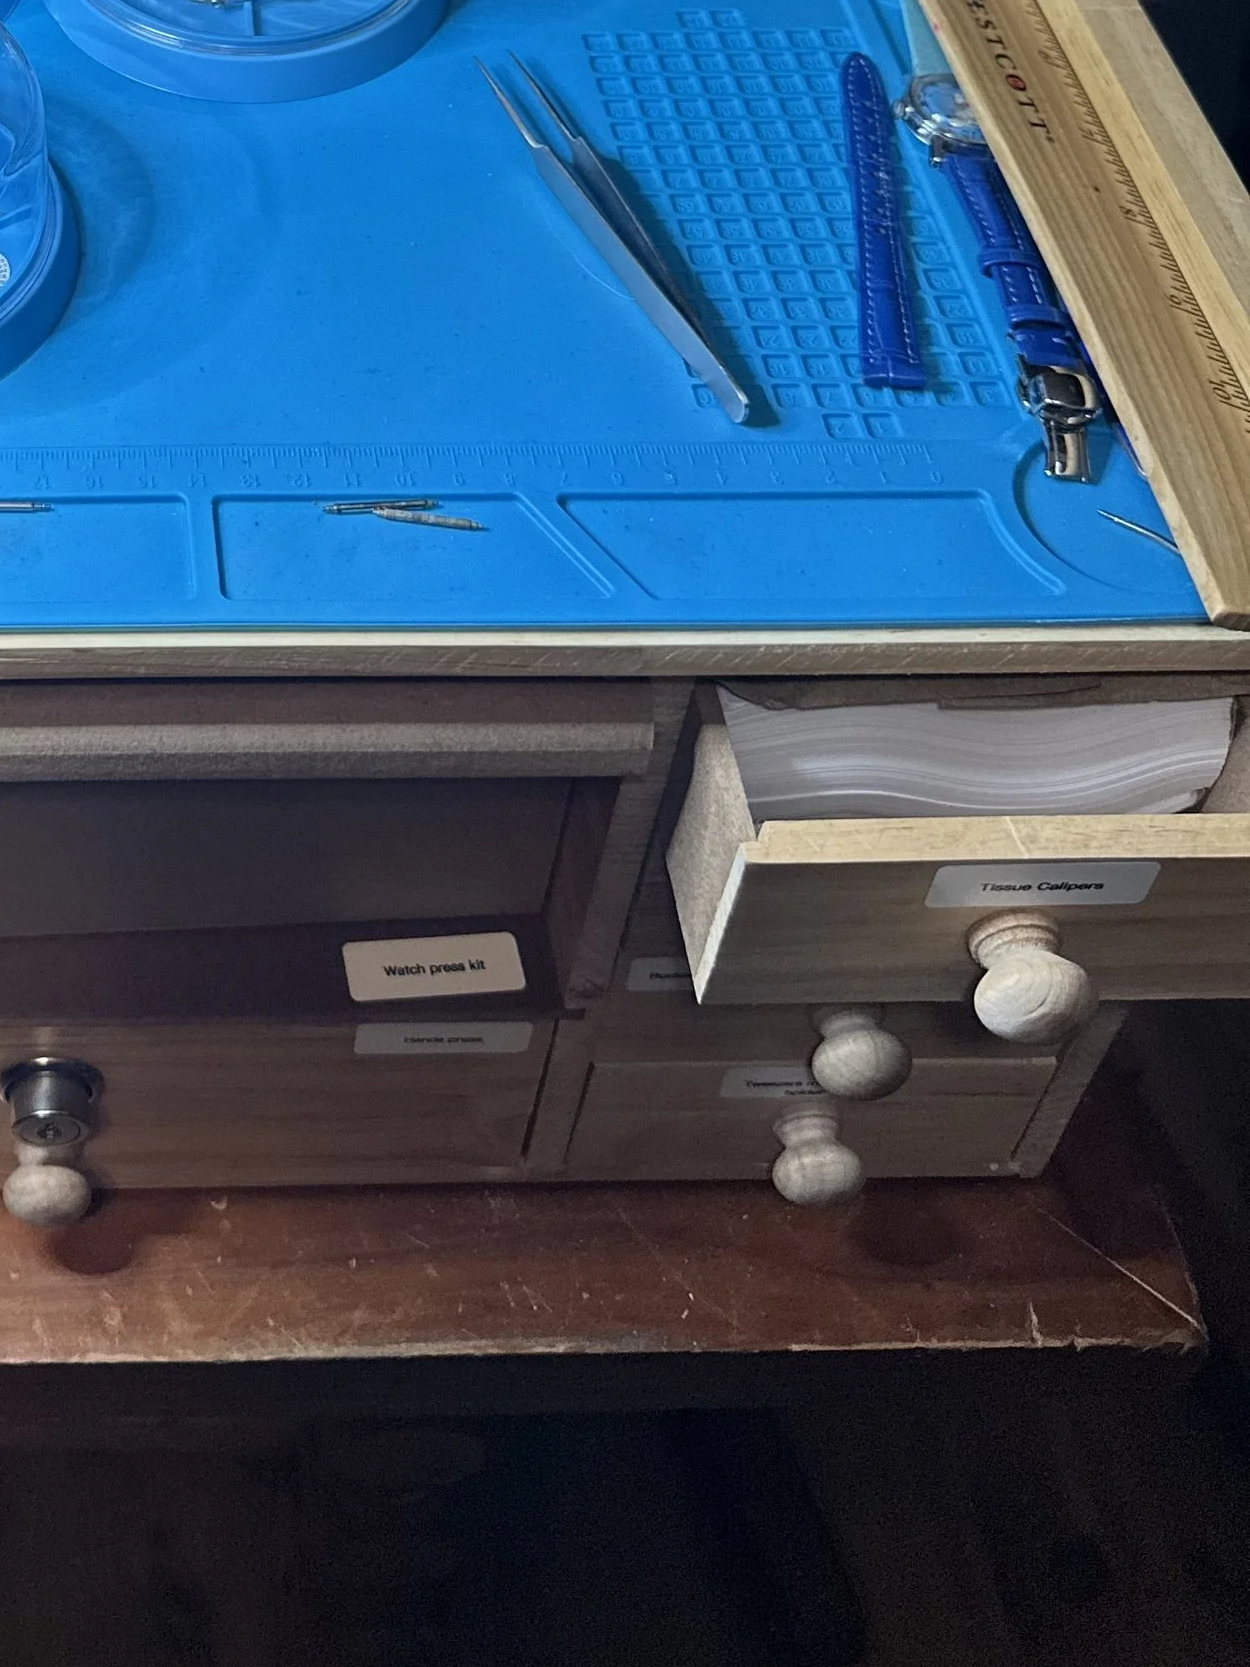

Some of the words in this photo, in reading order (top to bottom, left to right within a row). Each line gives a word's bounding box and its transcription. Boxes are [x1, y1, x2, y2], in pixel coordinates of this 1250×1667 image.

[980, 881, 1032, 892] Tissue
[1036, 880, 1105, 893] Calipers
[383, 961, 426, 977] Watch
[429, 961, 466, 976] press
[468, 958, 486, 971] kit
